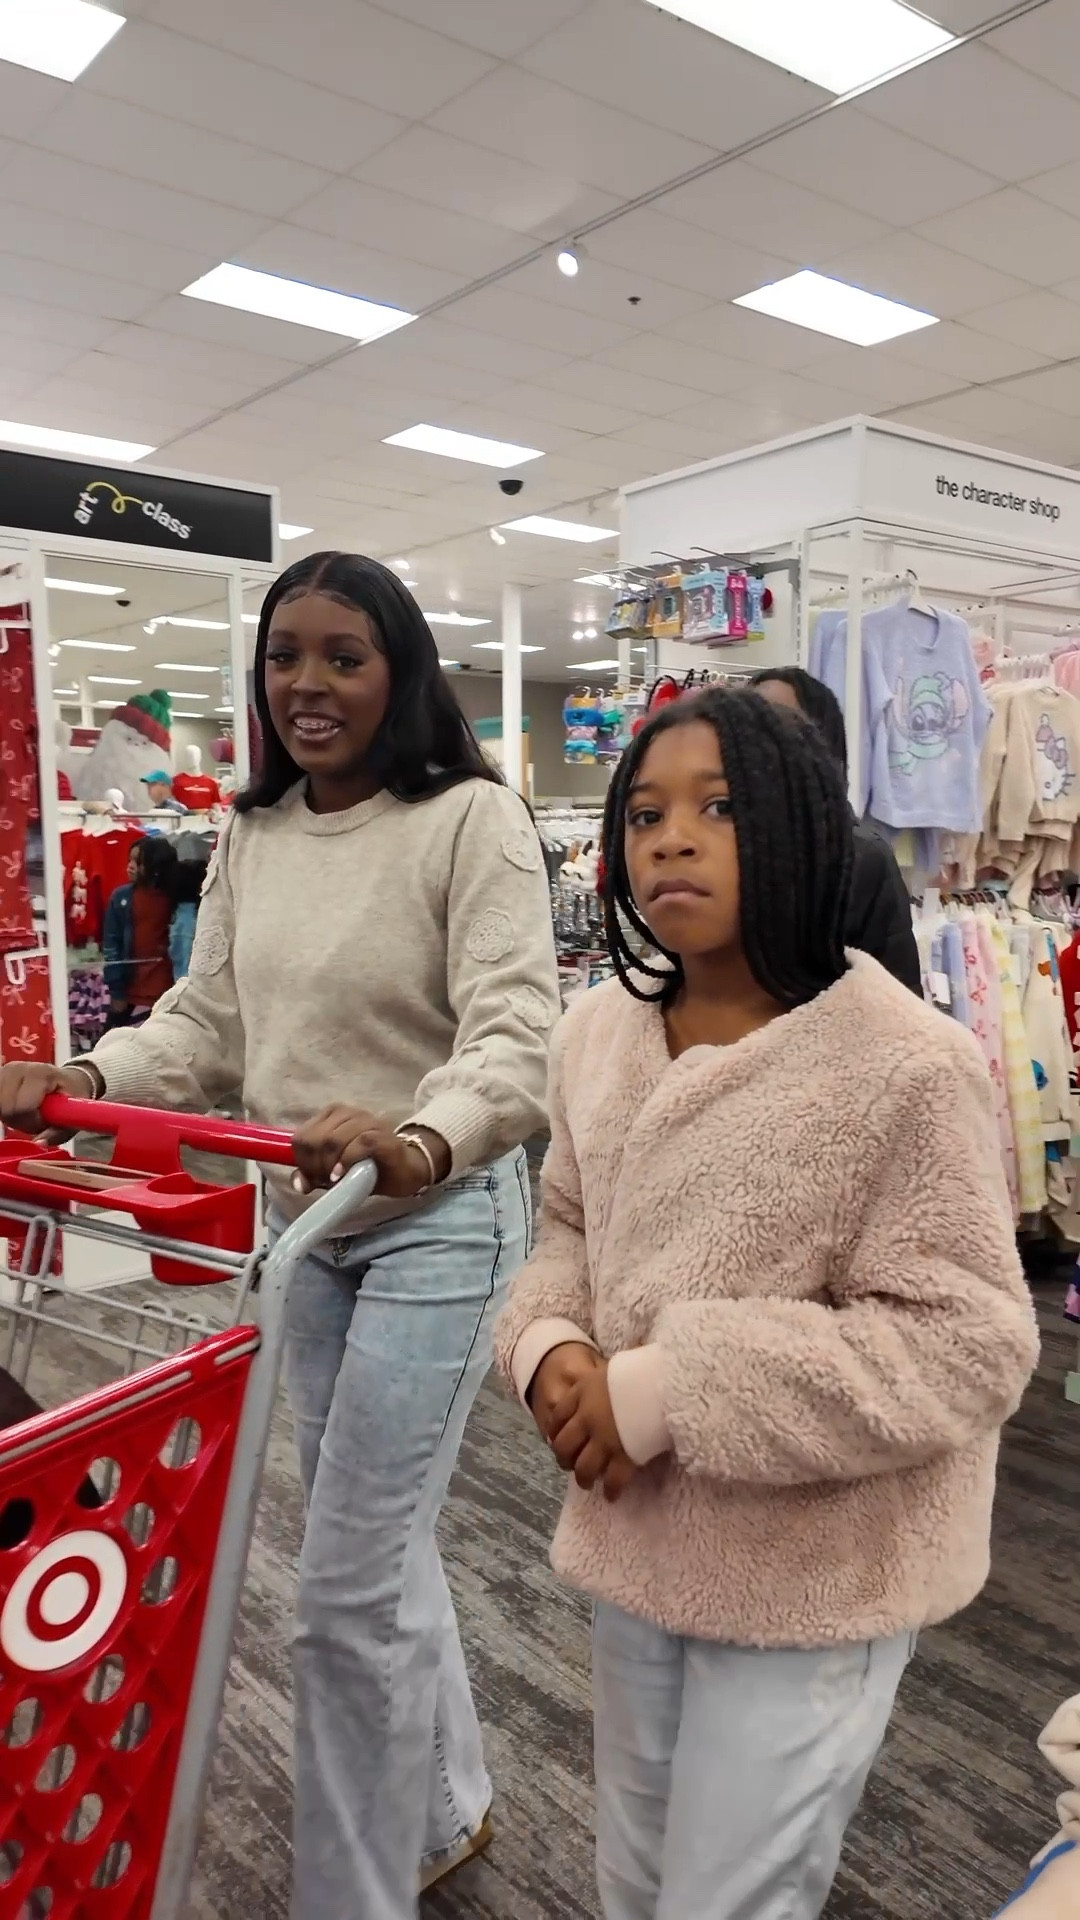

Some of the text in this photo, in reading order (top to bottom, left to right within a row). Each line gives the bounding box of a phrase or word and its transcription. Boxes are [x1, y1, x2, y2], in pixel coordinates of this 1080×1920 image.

[74, 492, 191, 539] art class
[936, 475, 1060, 522] the character shop
